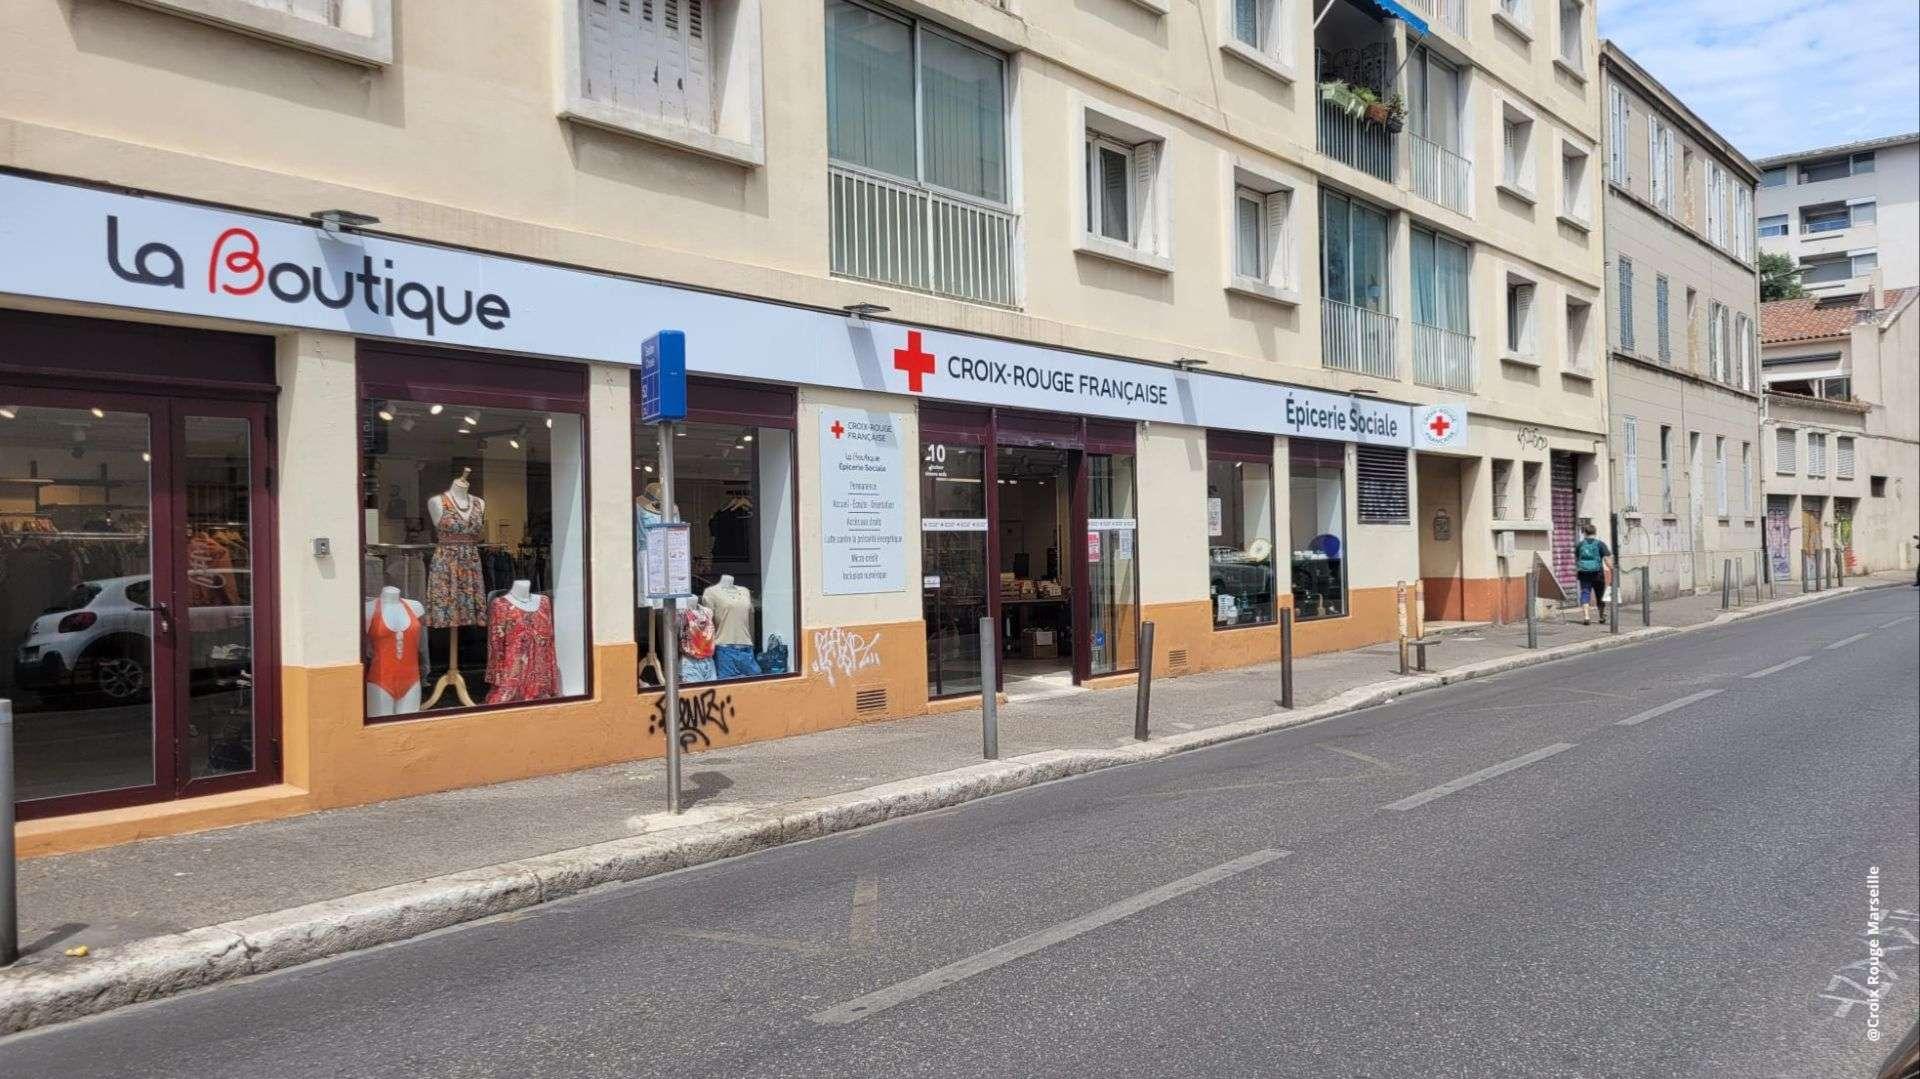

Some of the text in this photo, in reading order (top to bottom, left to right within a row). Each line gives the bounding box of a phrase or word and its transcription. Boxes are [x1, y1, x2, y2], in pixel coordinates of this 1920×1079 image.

[208, 227, 511, 336] Boutique
[948, 355, 1168, 407] CROIX-ROUGE FRANÇAISE
[848, 421, 893, 433] CROIX-ROUGE
[1285, 391, 1398, 438] Épicerie Sociale
[928, 444, 946, 462] 10
